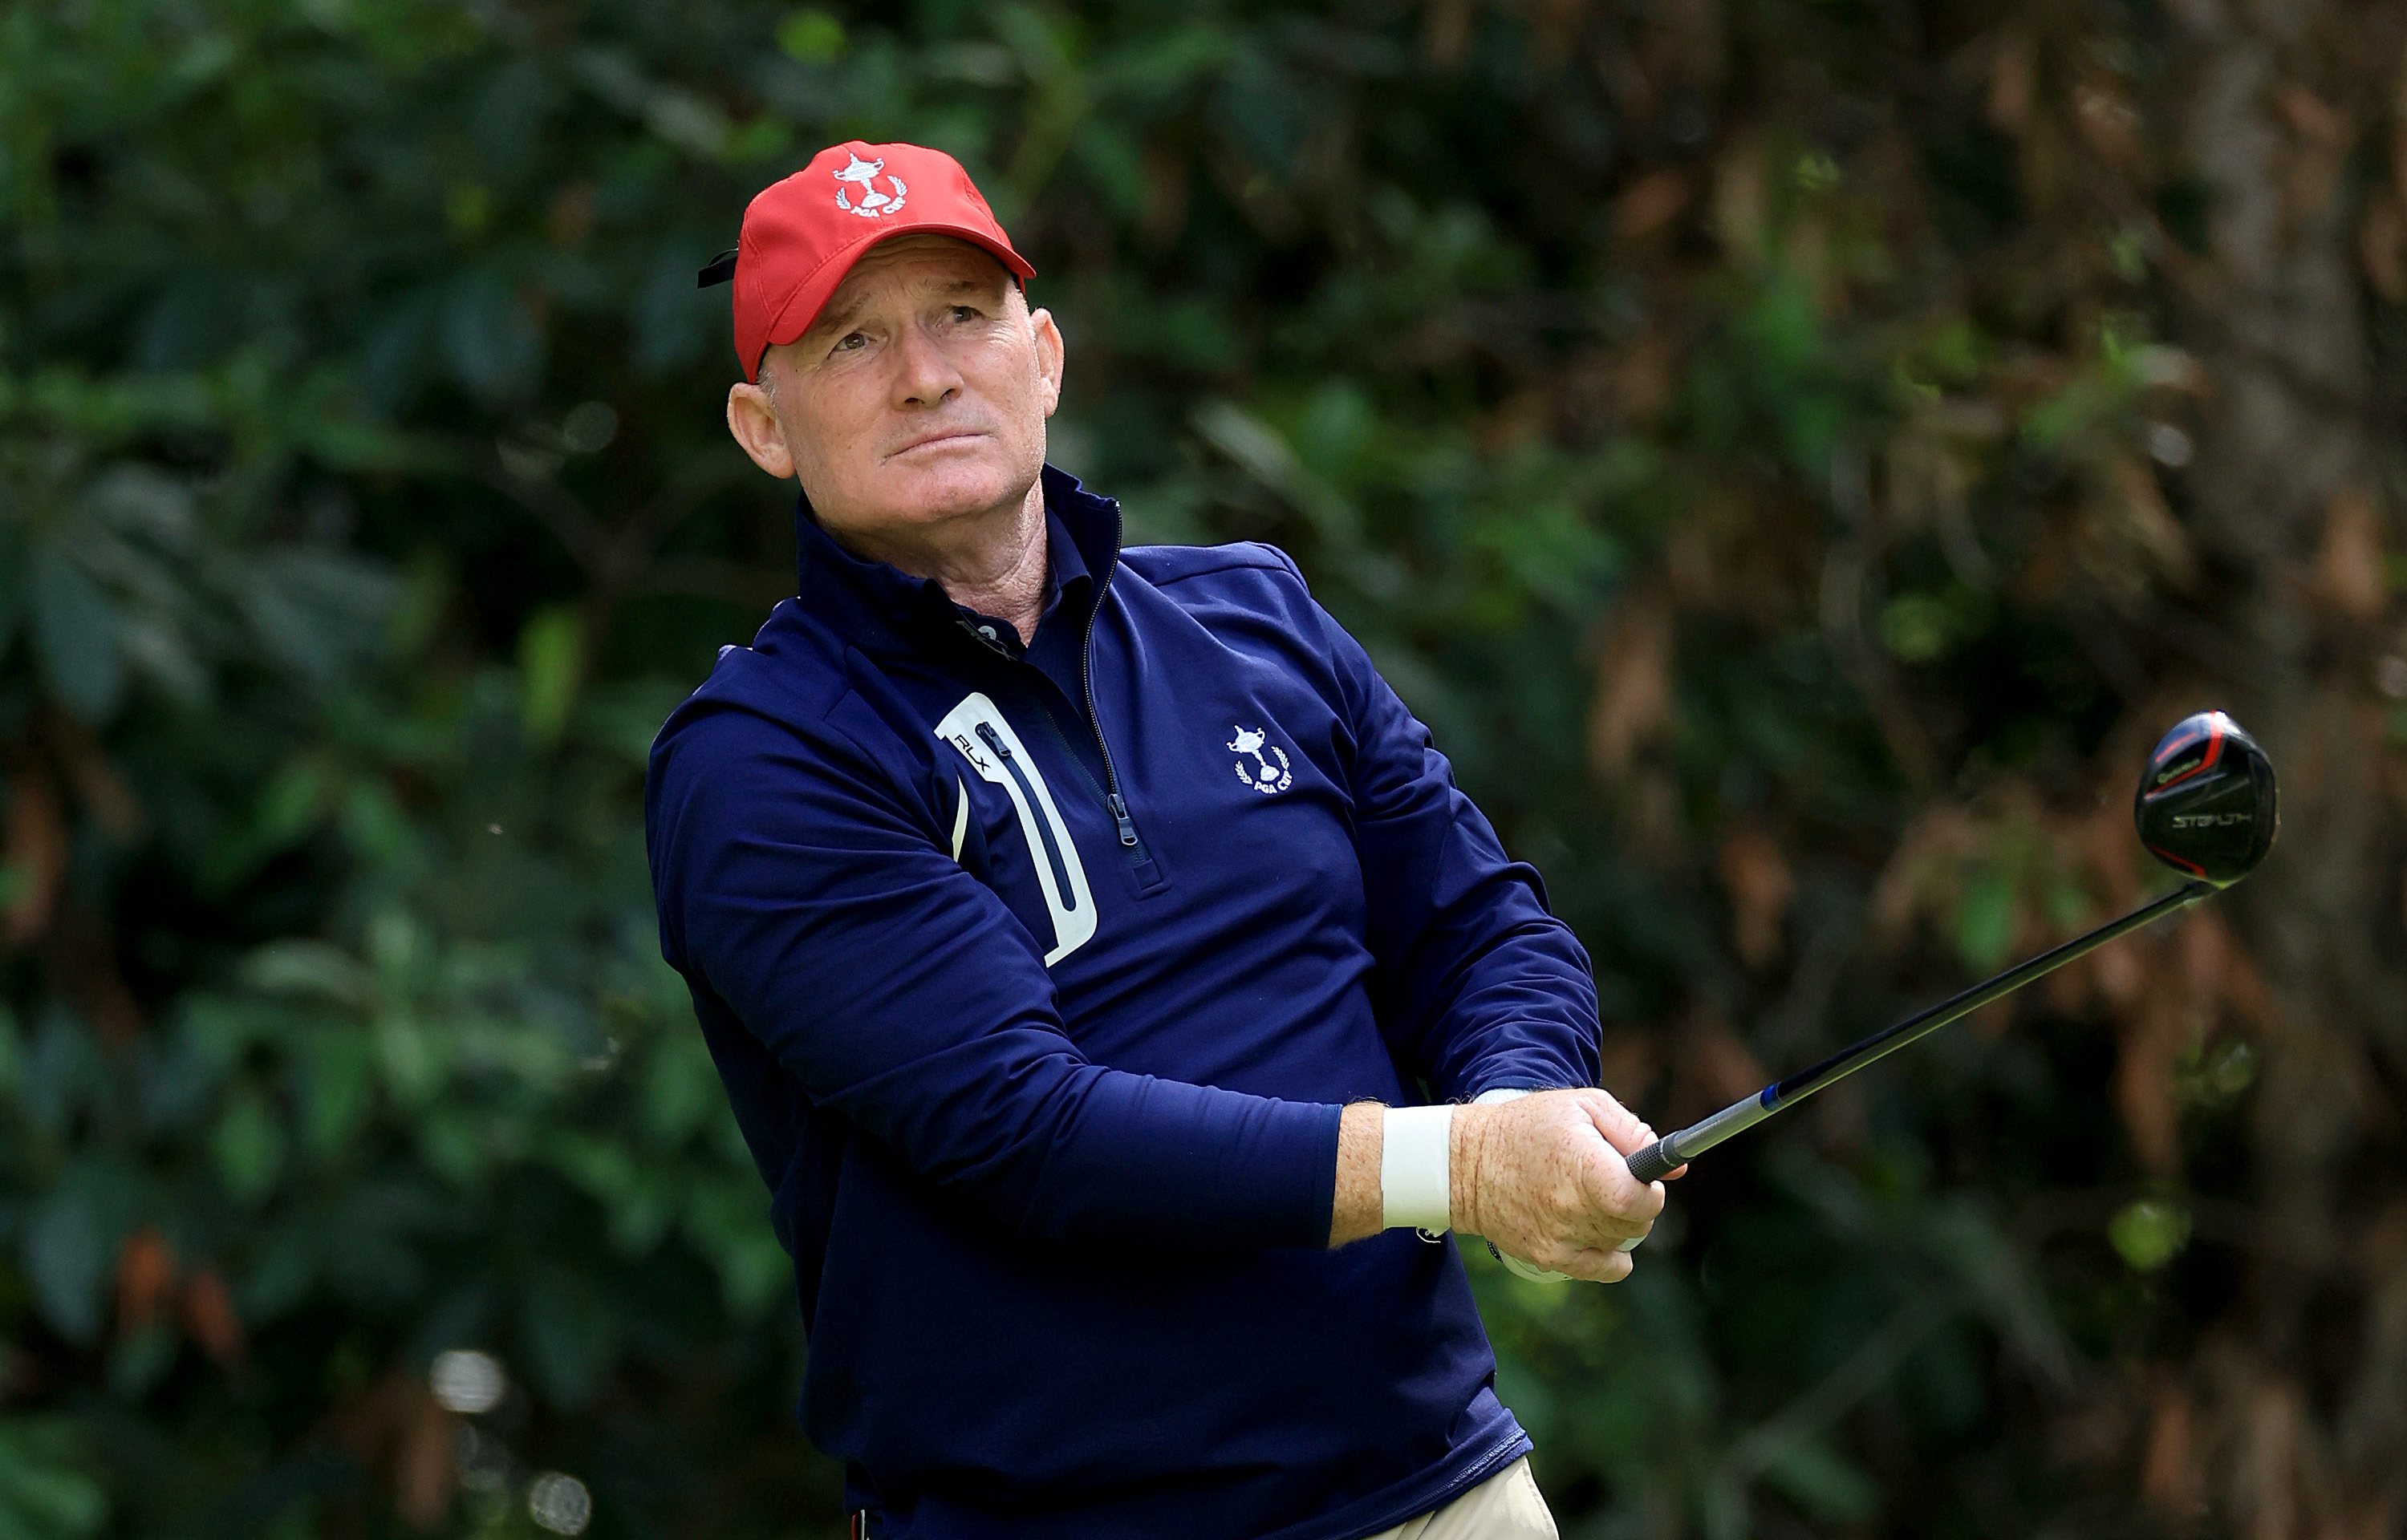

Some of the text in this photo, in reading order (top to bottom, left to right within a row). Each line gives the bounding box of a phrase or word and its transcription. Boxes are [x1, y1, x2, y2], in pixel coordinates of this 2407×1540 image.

[850, 196, 906, 217] PGA CUP
[954, 734, 990, 773] RLX
[1253, 770, 1293, 794] PGA CUP
